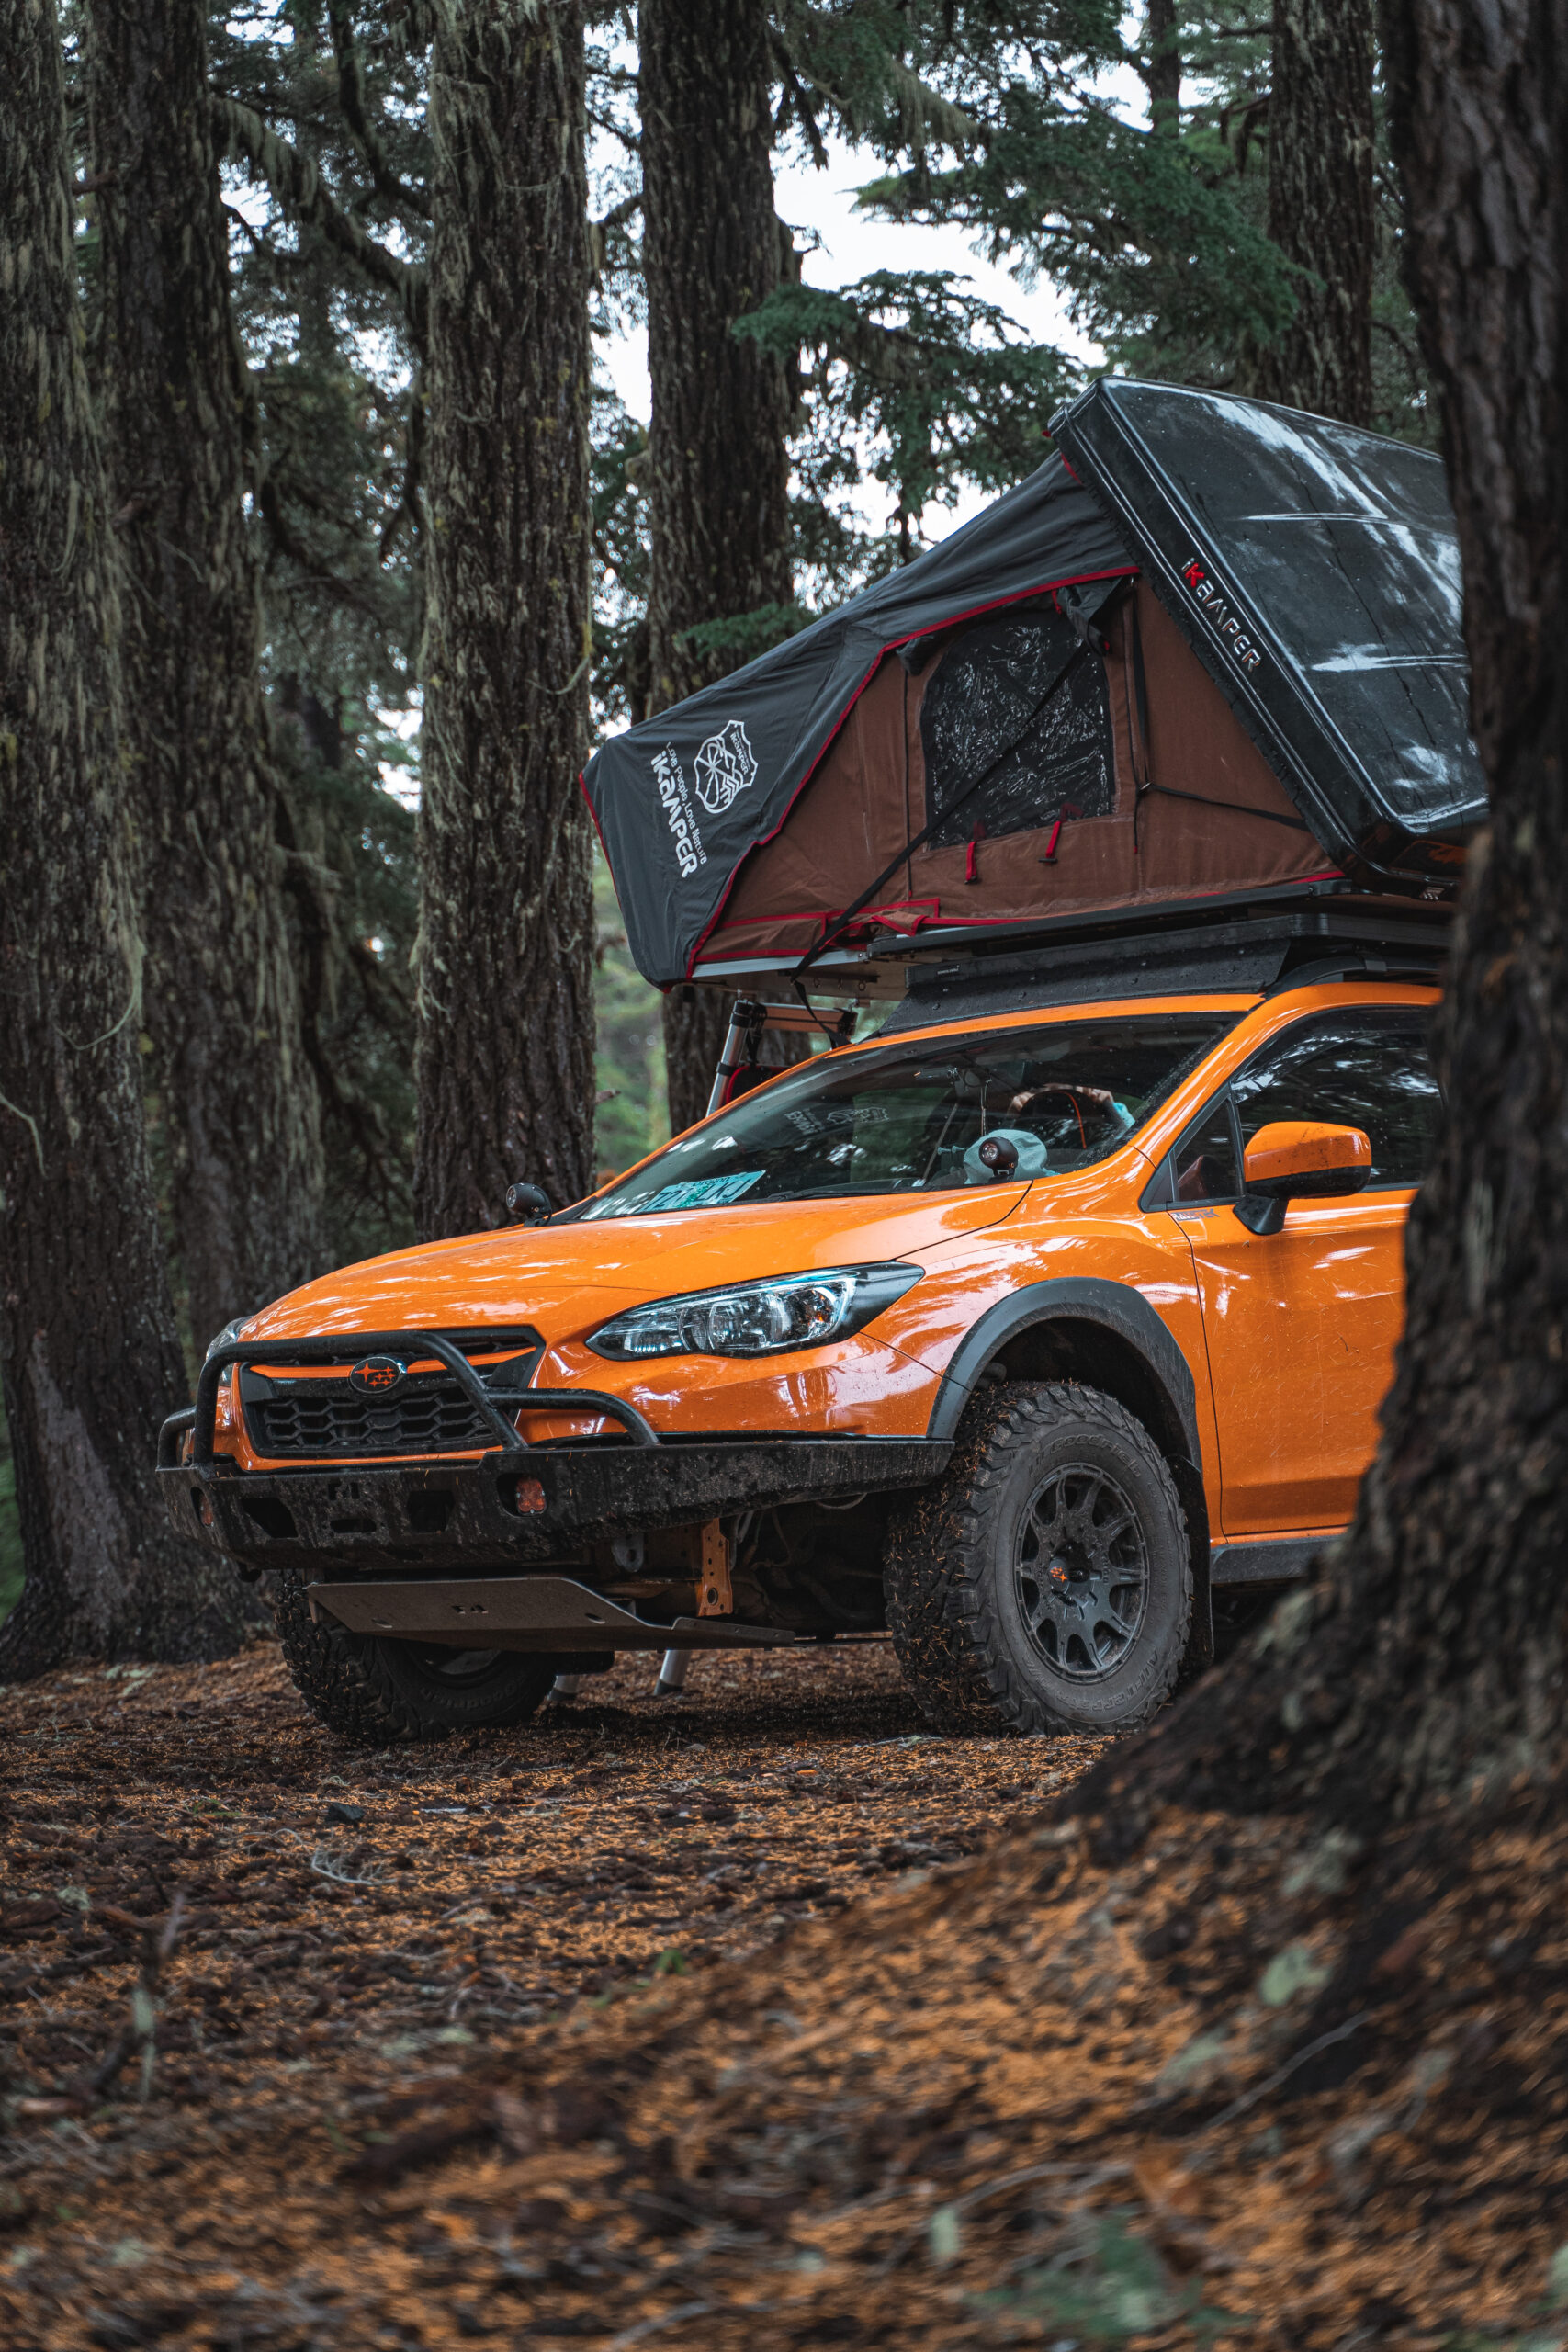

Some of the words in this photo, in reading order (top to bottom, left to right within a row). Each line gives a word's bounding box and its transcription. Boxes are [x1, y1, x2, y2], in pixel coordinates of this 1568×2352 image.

[666, 741, 678, 767] Love
[683, 803, 696, 830] Love
[691, 829, 707, 865] Nature
[694, 1178, 751, 1202] LKJ
